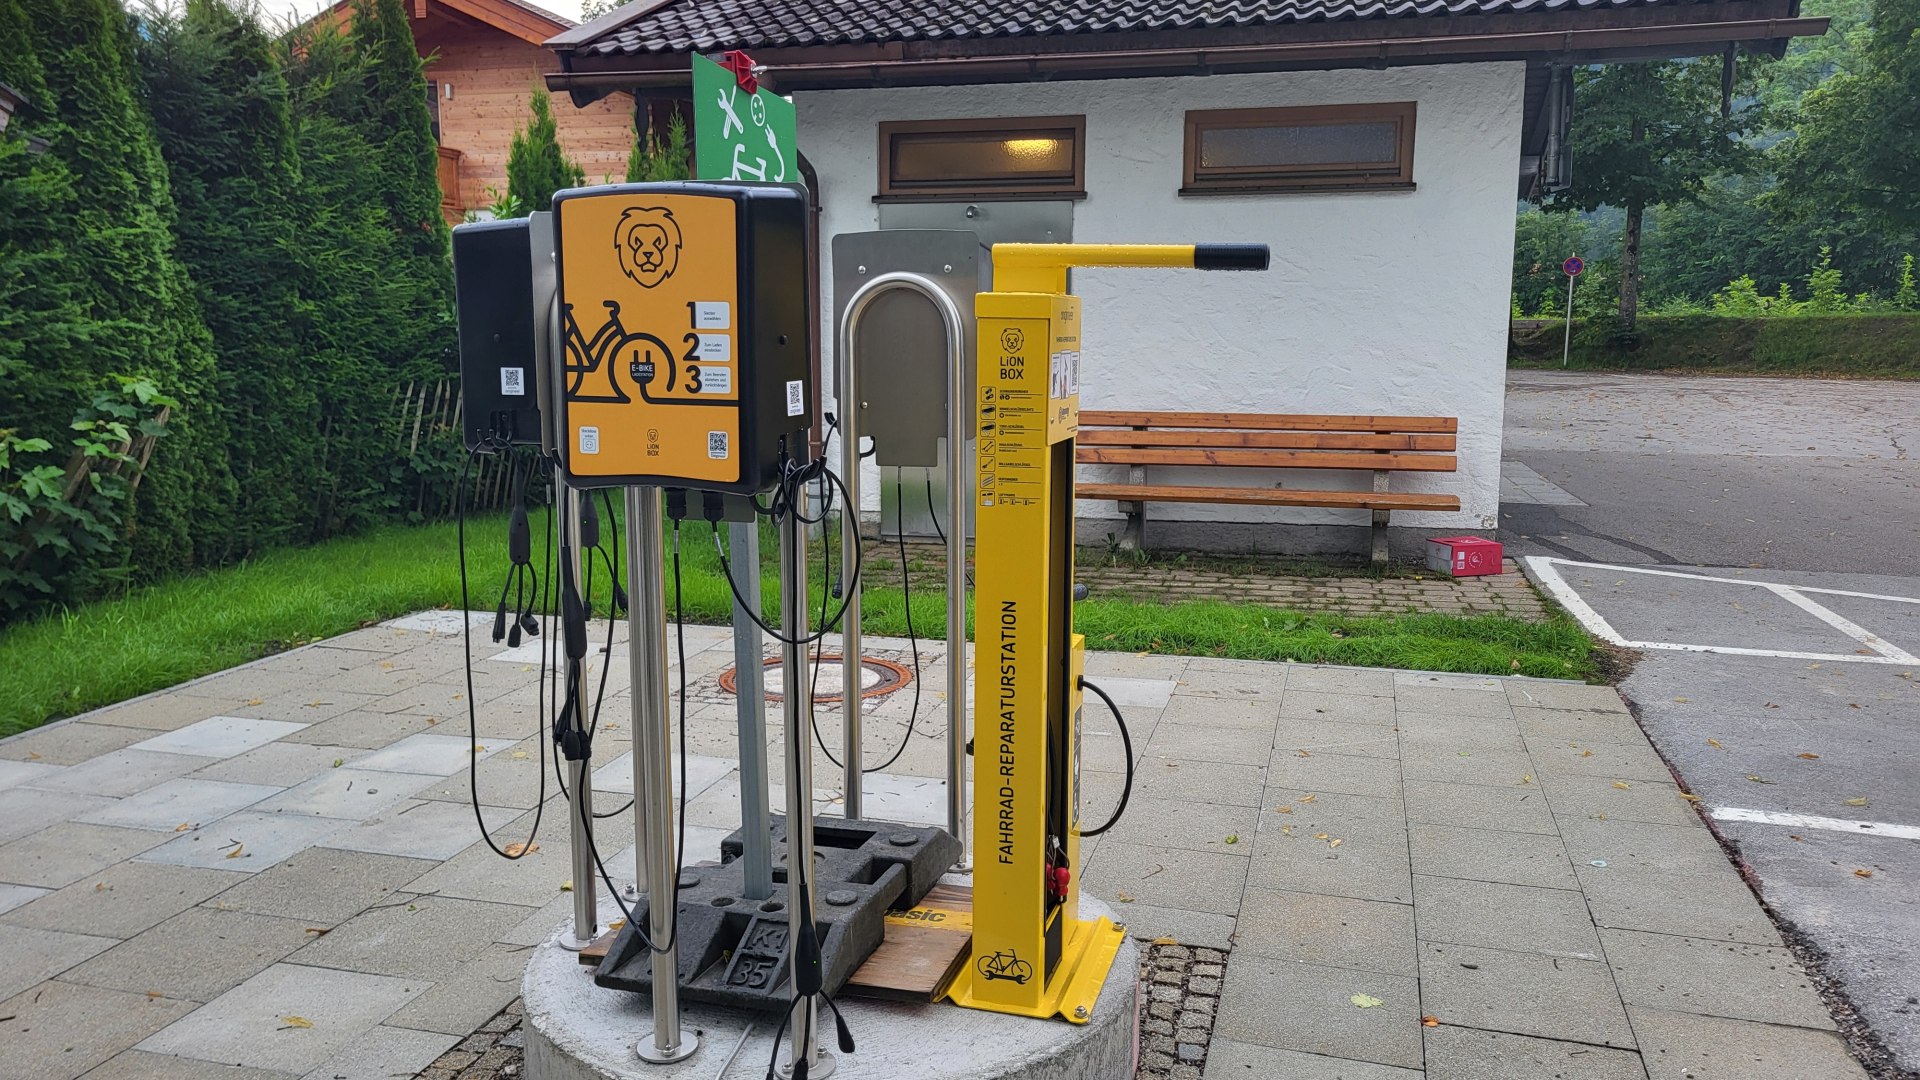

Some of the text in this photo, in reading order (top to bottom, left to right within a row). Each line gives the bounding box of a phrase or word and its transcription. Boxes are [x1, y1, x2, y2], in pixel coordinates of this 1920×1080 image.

[686, 301, 697, 330] 1
[682, 332, 700, 361] 2
[631, 364, 654, 372] E-BIKE
[685, 364, 703, 394] 3
[1000, 368, 1024, 380] BOX
[998, 601, 1017, 864] FAHRRAD-REPARATURSTATION
[730, 961, 775, 988] 35
